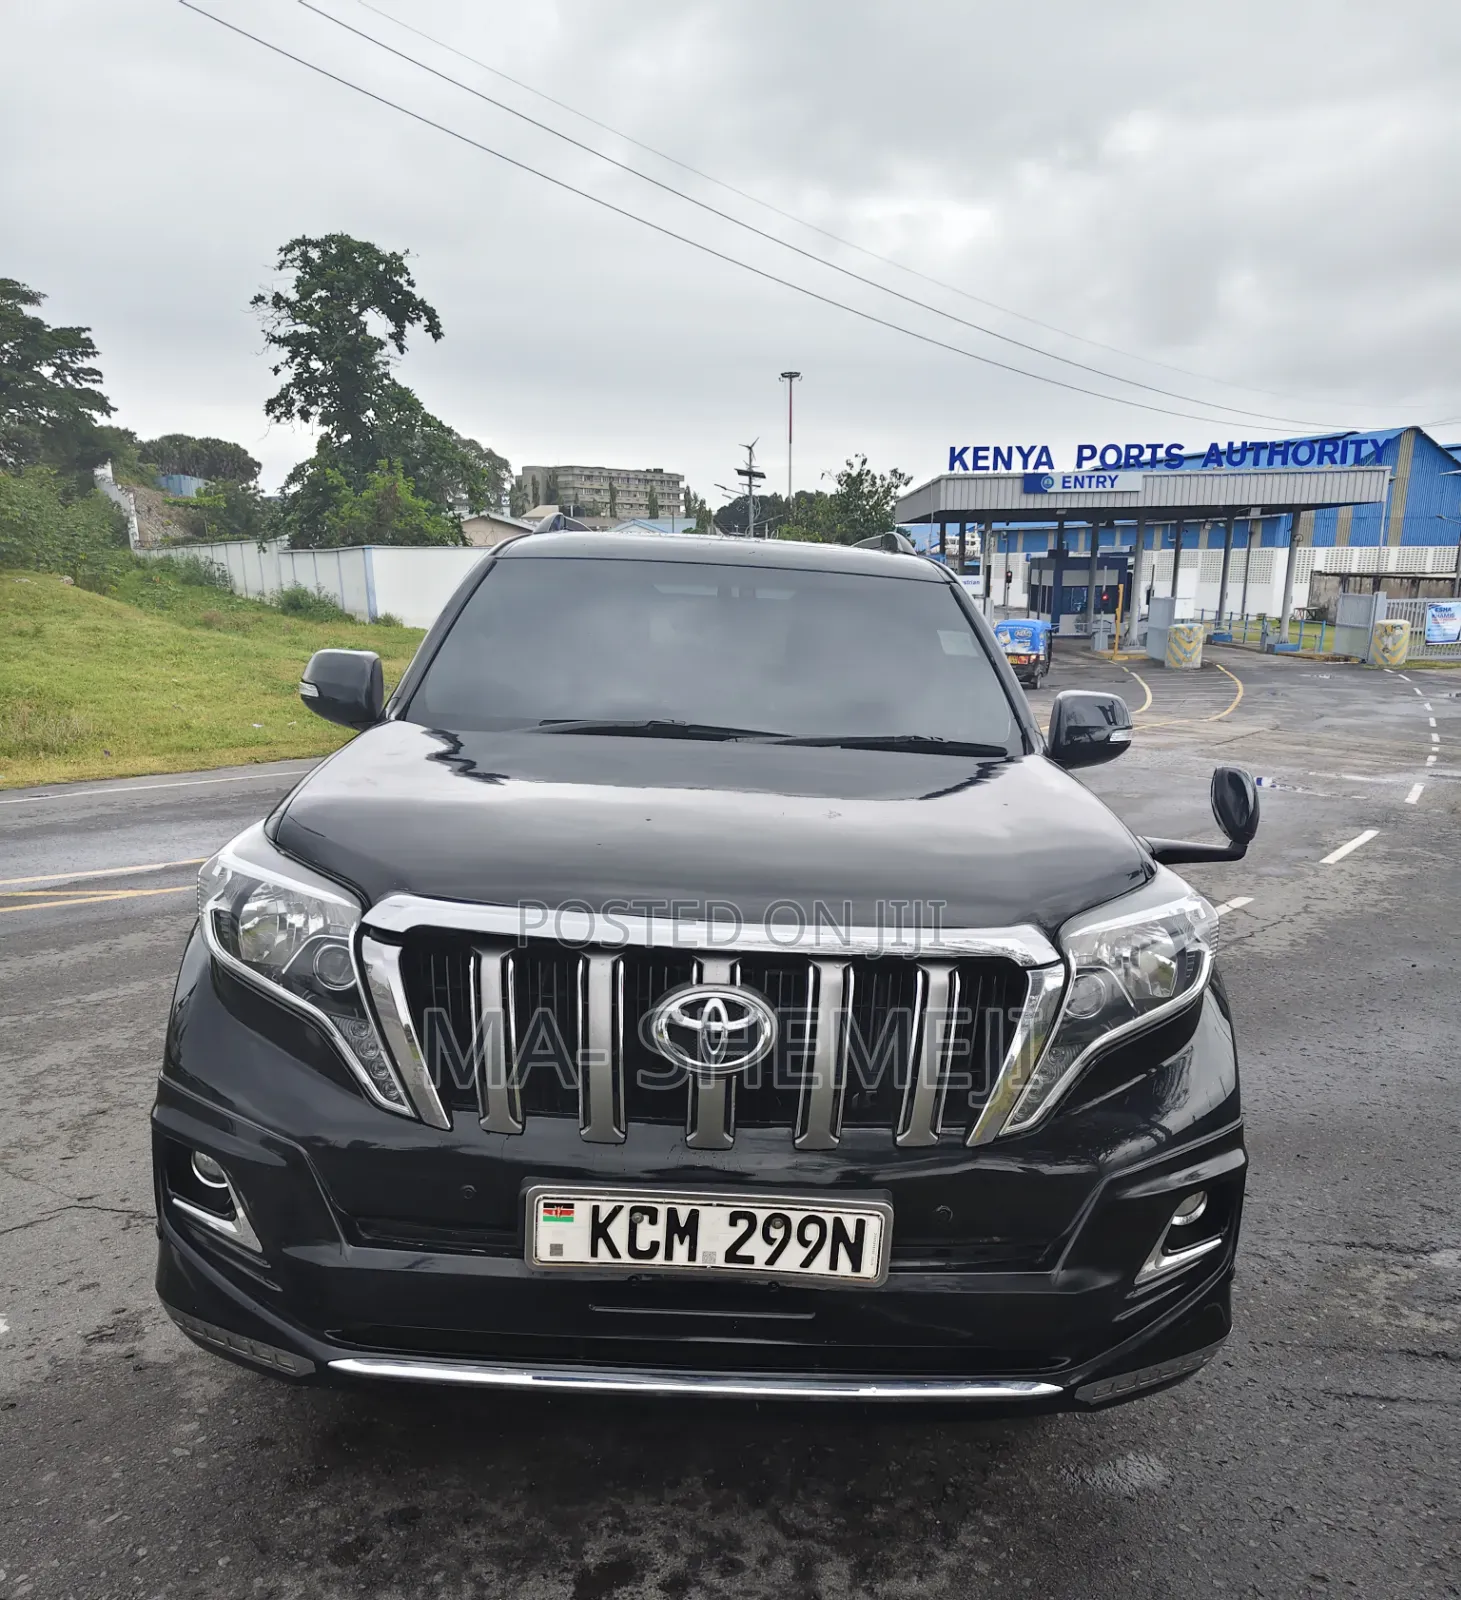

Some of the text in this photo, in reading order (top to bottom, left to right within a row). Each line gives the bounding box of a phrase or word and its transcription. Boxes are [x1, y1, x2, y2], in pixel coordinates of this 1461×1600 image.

[949, 438, 1394, 471] KENYA PORTS AUTHORITY
[1061, 474, 1119, 489] ENTRY
[590, 1204, 700, 1262] KCM
[724, 1210, 868, 1273] 299N
